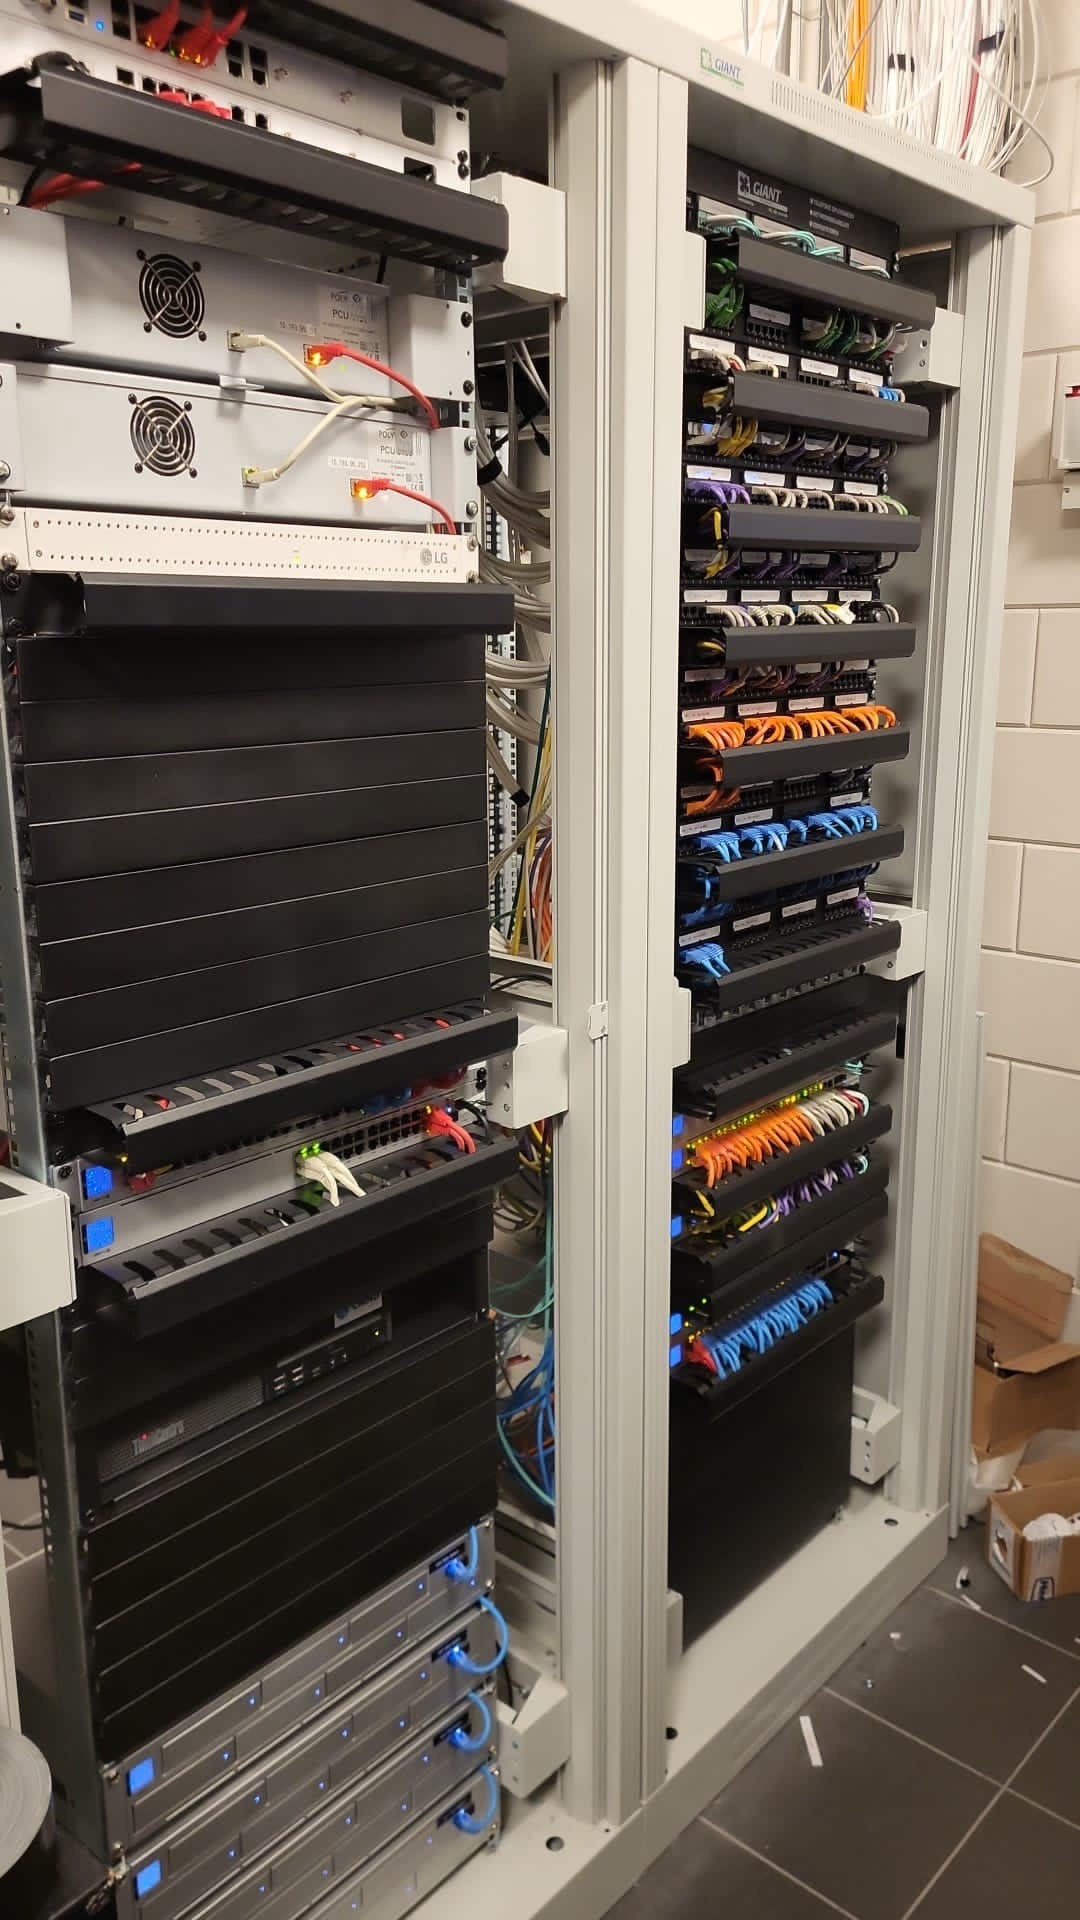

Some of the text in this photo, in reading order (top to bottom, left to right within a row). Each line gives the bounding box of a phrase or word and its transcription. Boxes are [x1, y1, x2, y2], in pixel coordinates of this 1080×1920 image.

[715, 58, 741, 80] GIANT
[753, 181, 782, 203] GIANT
[332, 309, 349, 320] PCU
[434, 551, 448, 564] LG
